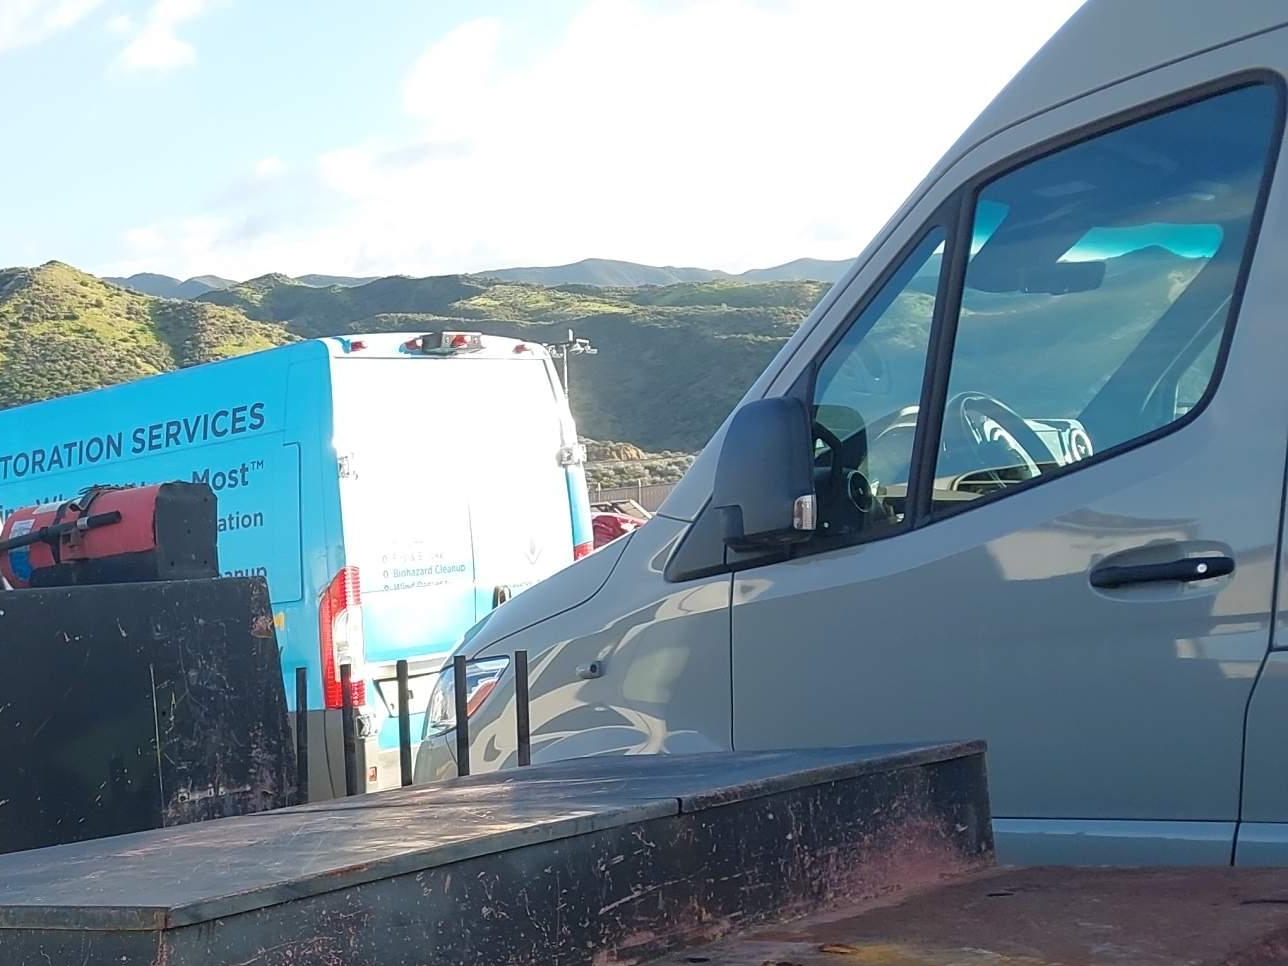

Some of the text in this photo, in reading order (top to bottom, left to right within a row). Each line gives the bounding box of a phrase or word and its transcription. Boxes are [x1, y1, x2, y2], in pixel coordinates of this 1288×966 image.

[131, 402, 265, 454] SERVICES
[392, 564, 466, 578] Biohazard Cleanup
